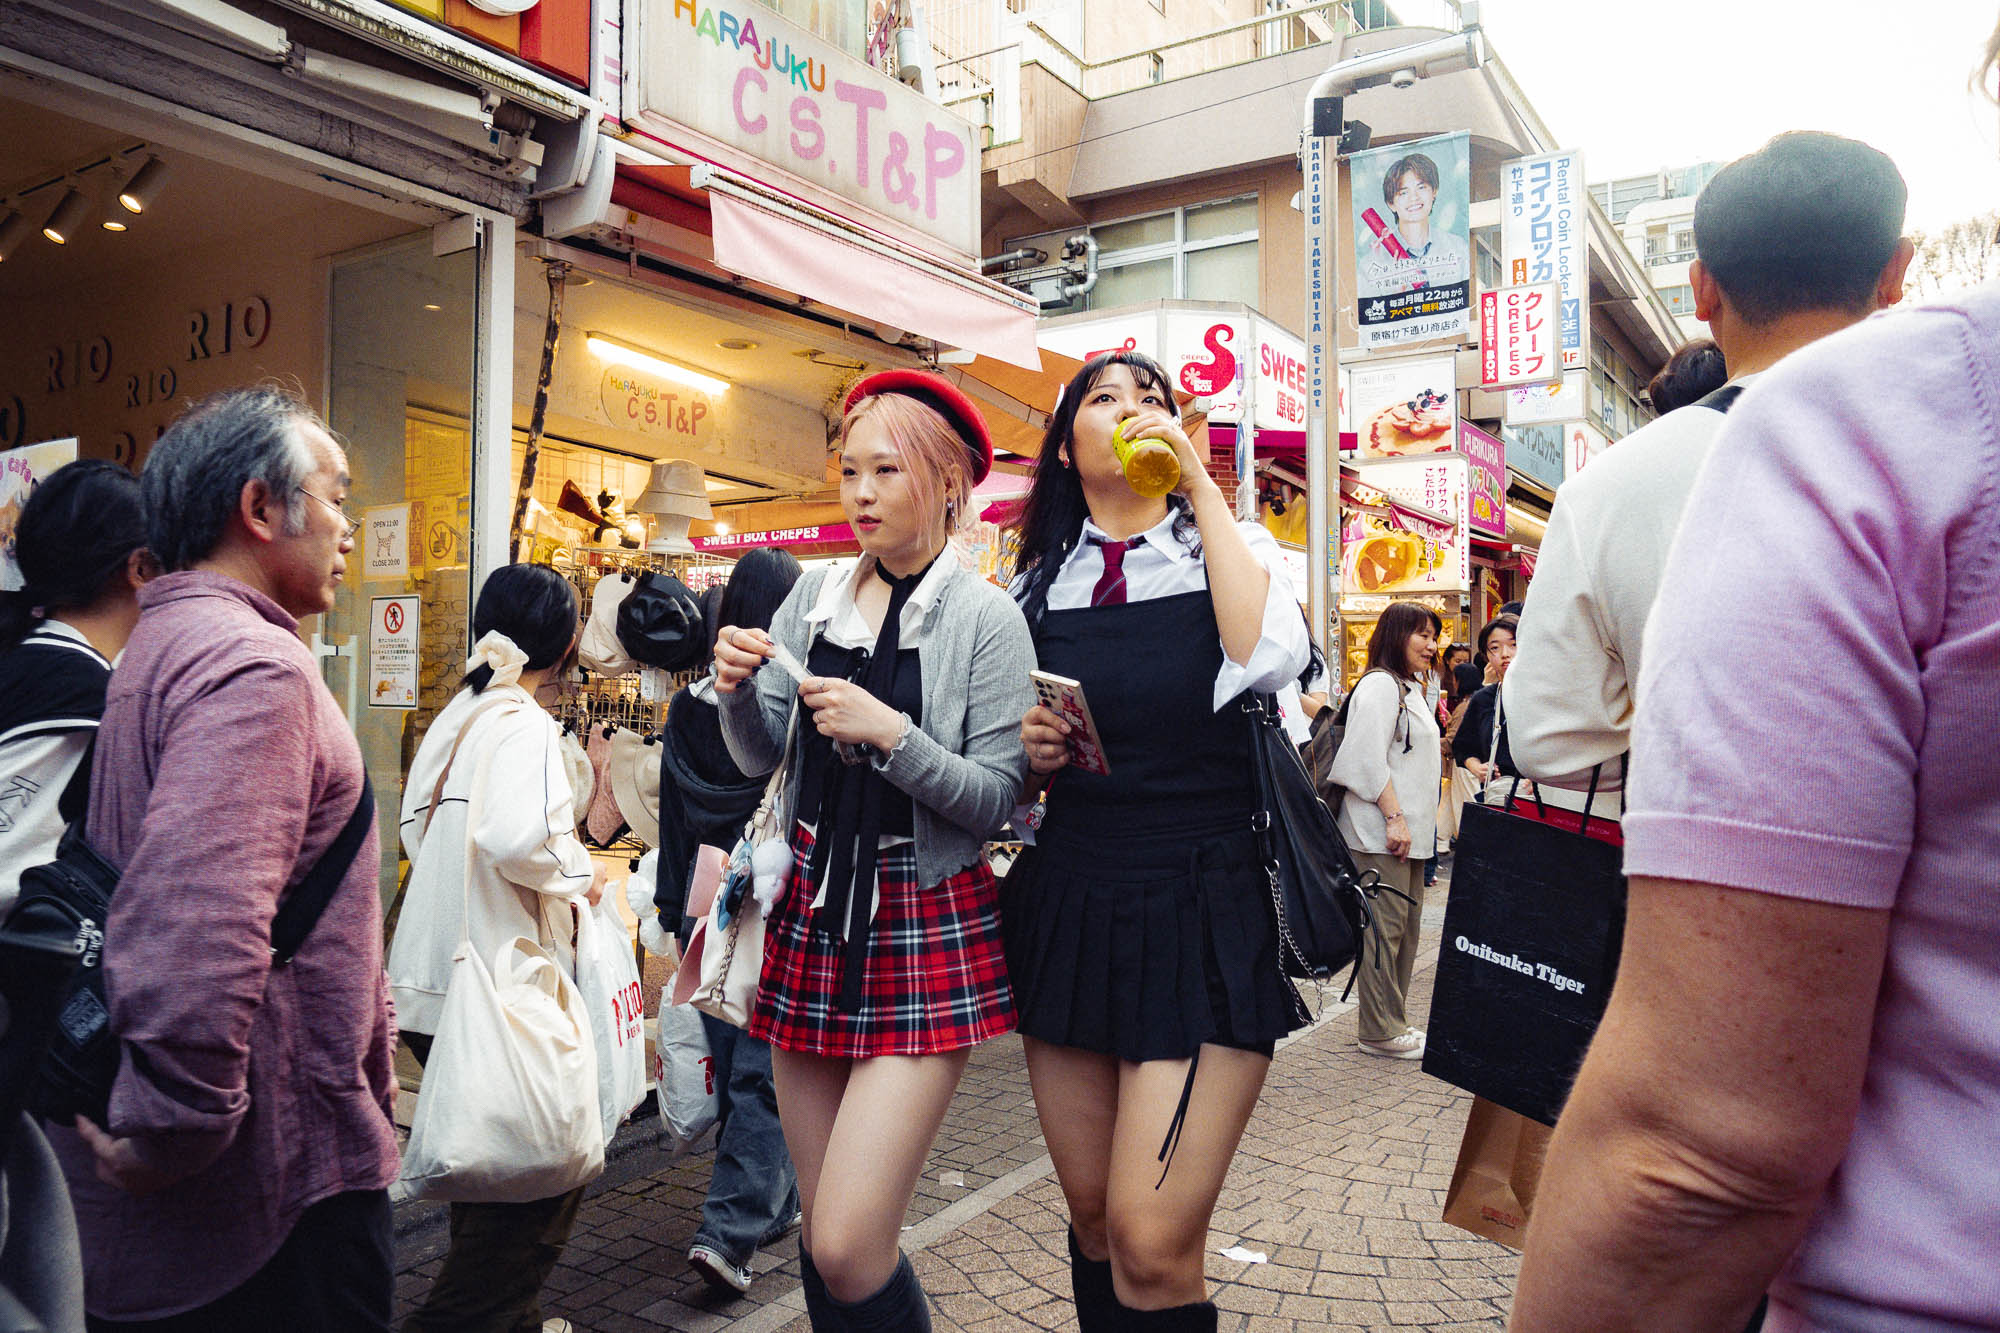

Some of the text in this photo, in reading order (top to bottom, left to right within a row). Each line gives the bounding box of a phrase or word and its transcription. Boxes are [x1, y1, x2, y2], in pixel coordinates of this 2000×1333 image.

[674, 0, 826, 92] HARAJUKU
[1311, 141, 1320, 225] HARAJUKU
[1511, 167, 1524, 217] 竹下通り
[1557, 157, 1570, 205] Rental
[1530, 161, 1553, 282] コインロッカ
[1559, 209, 1571, 242] Coin
[1312, 237, 1321, 332] TAKESHITA
[1559, 246, 1572, 296] Locker
[186, 295, 271, 362] RIO
[1371, 318, 1460, 341] 原宿竹下通り商店会
[1484, 296, 1496, 380] SWEET BOX
[1507, 293, 1520, 376] CREPES
[1524, 291, 1546, 374] クレープ
[610, 375, 658, 401] HARAJUKU
[1261, 342, 1306, 396] SWEE
[1464, 431, 1499, 468] PURIKURA
[372, 559, 387, 567] CLOSE
[1455, 935, 1586, 995] Onitsuka Tiger
